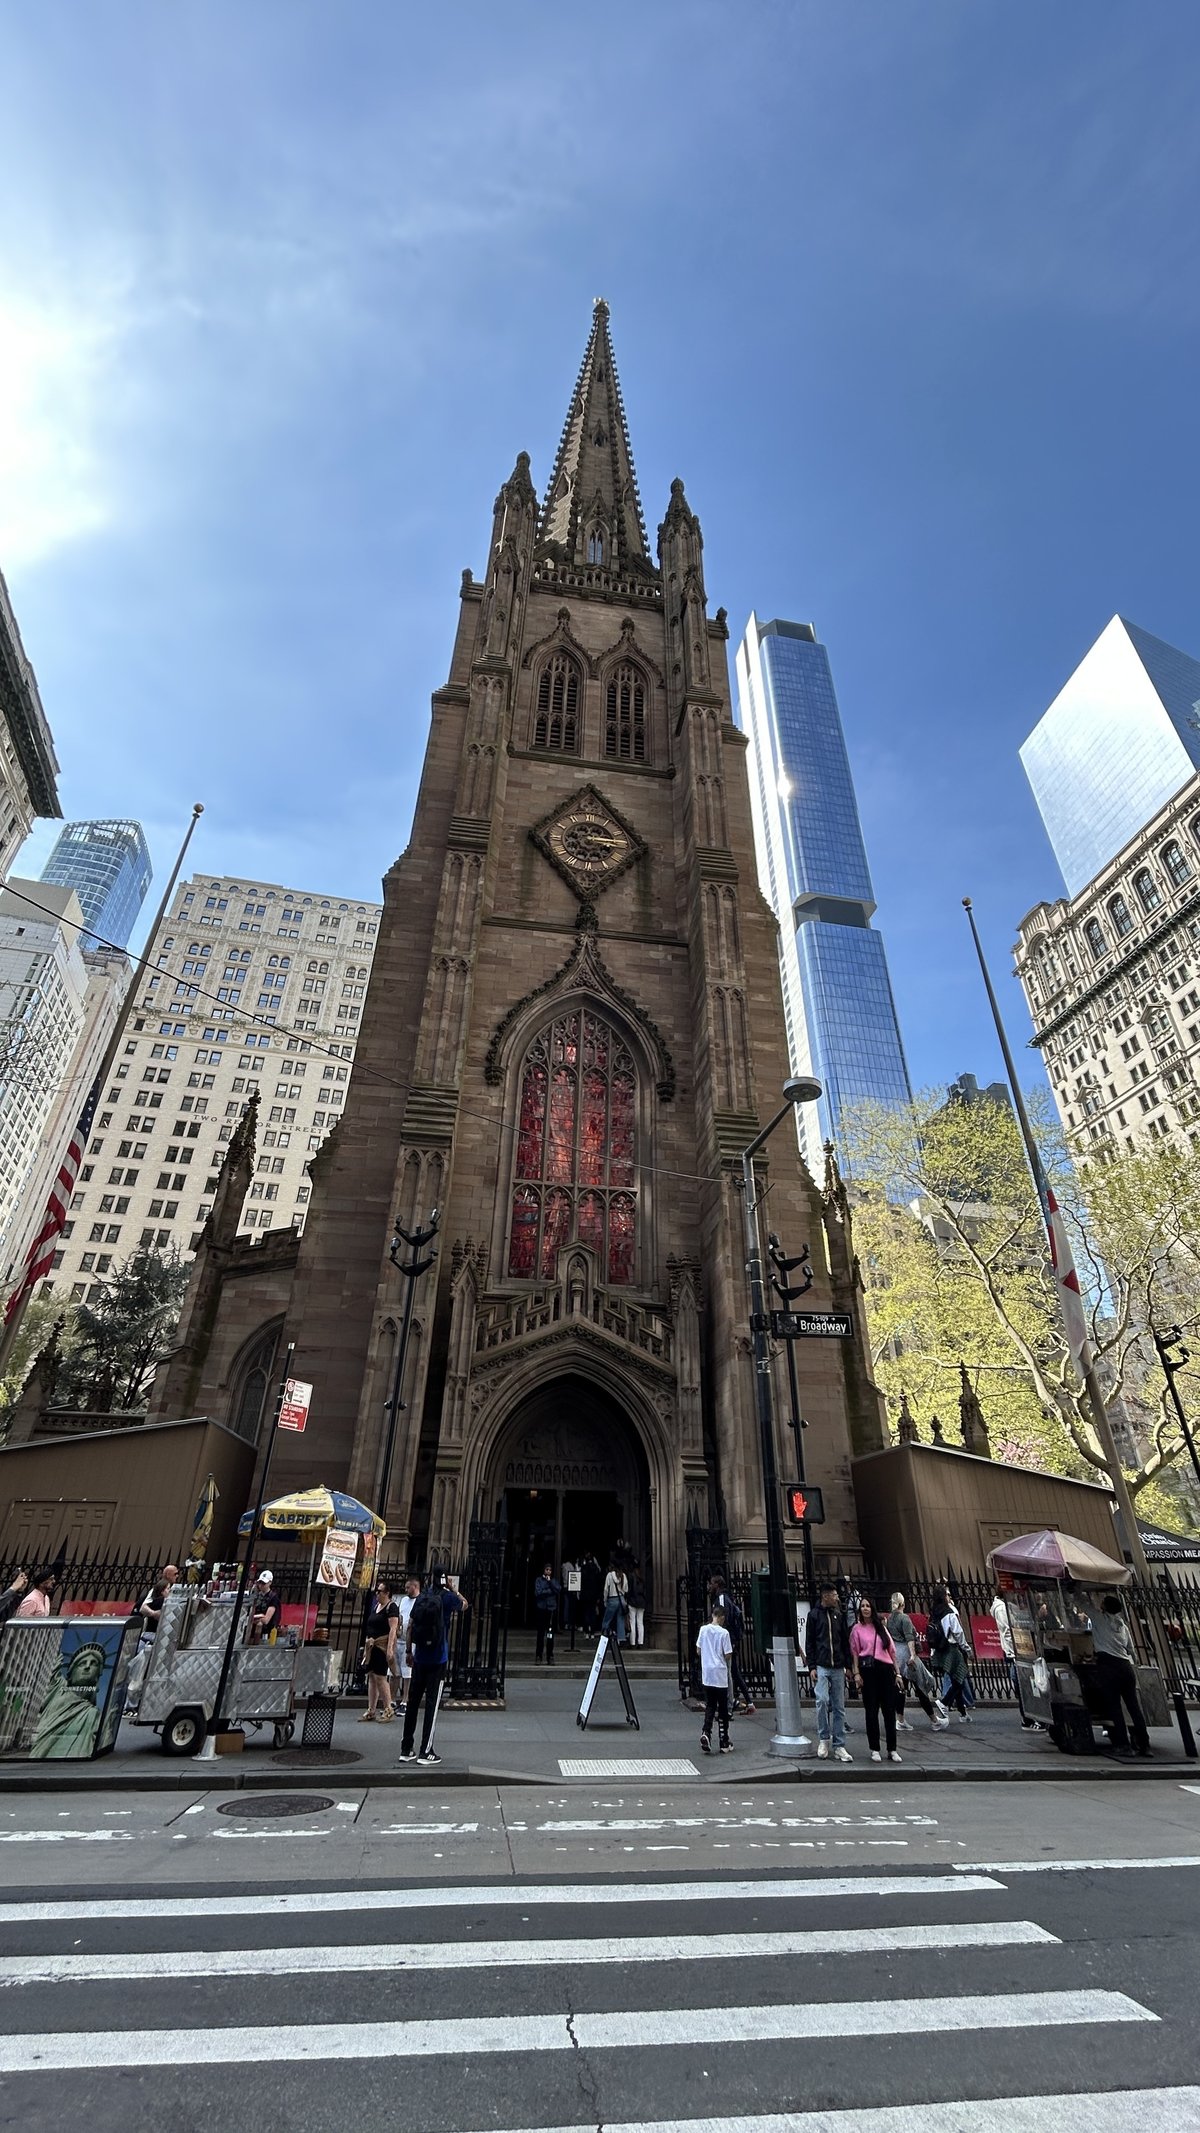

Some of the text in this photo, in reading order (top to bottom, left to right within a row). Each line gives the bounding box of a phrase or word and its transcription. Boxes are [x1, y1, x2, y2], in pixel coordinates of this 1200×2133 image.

[193, 1114, 324, 1134] TWO REOR STREET
[800, 1320, 846, 1333] Broadway
[267, 1513, 329, 1526] SABRETT
[1143, 1549, 1184, 1559] MPASSION
